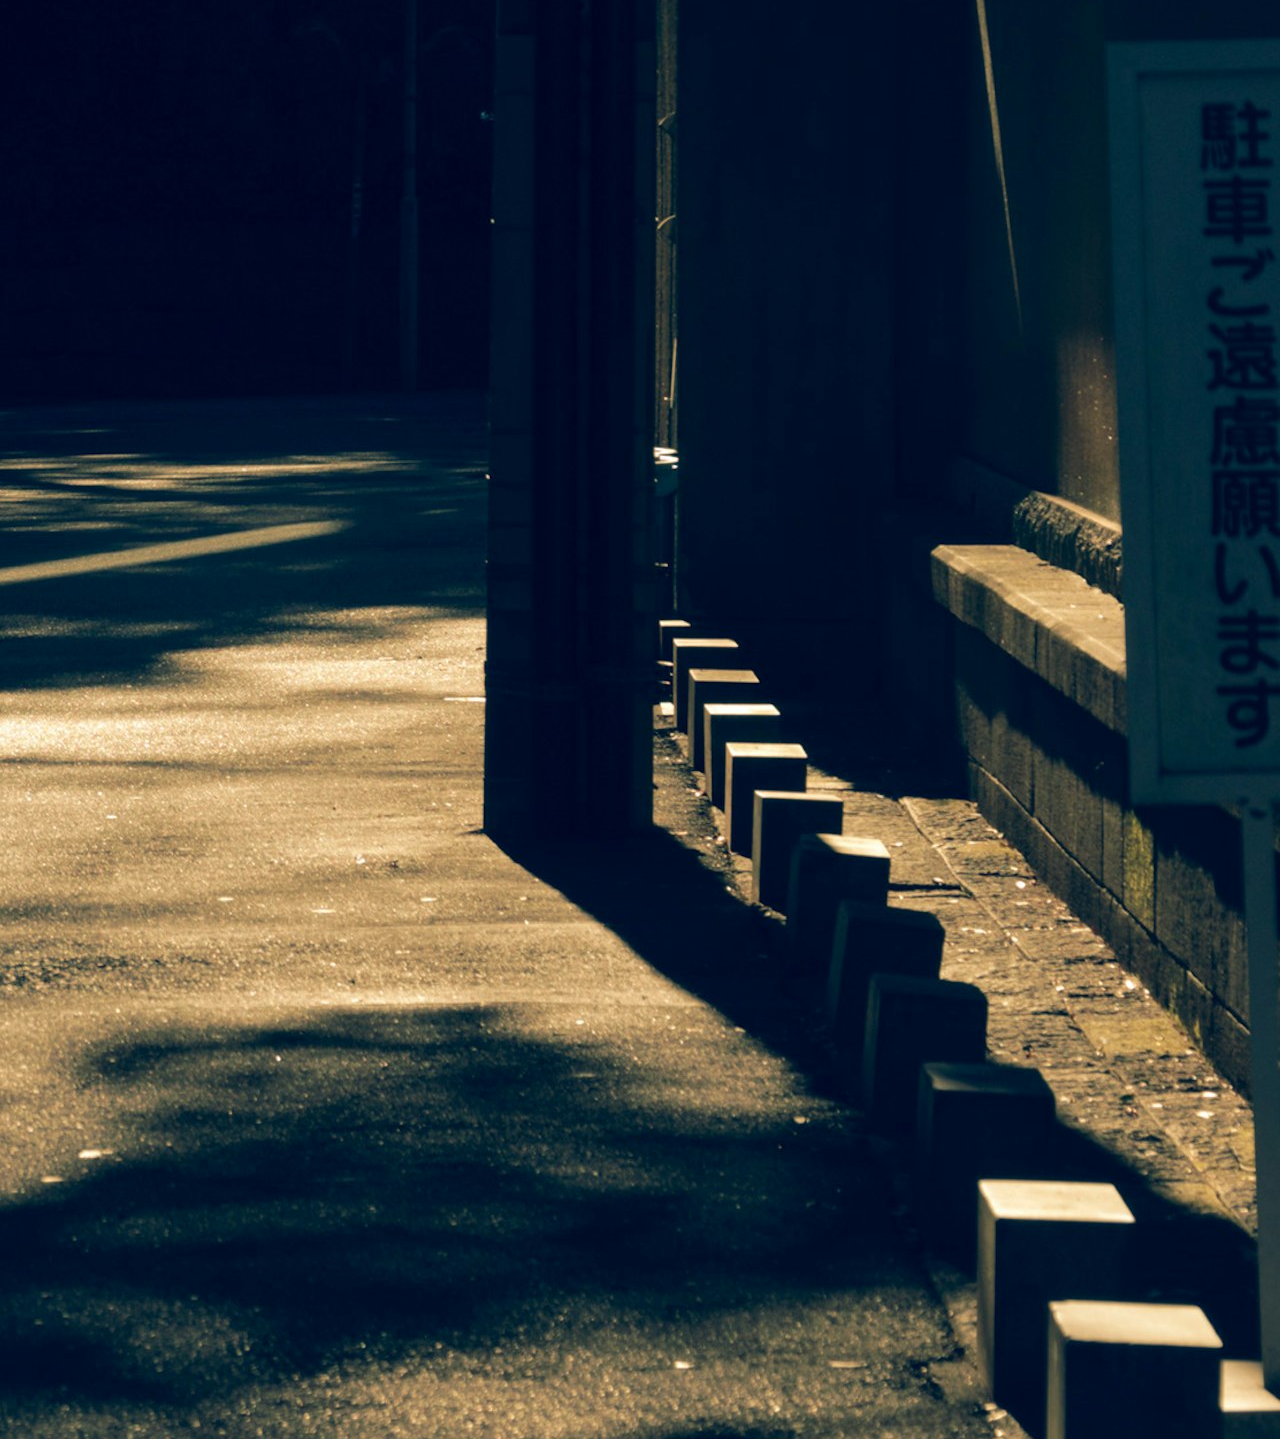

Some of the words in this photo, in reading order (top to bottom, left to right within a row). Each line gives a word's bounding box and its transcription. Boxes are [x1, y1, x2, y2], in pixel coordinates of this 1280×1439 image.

[1200, 99, 1280, 748] 駐車ご遠慮願います
